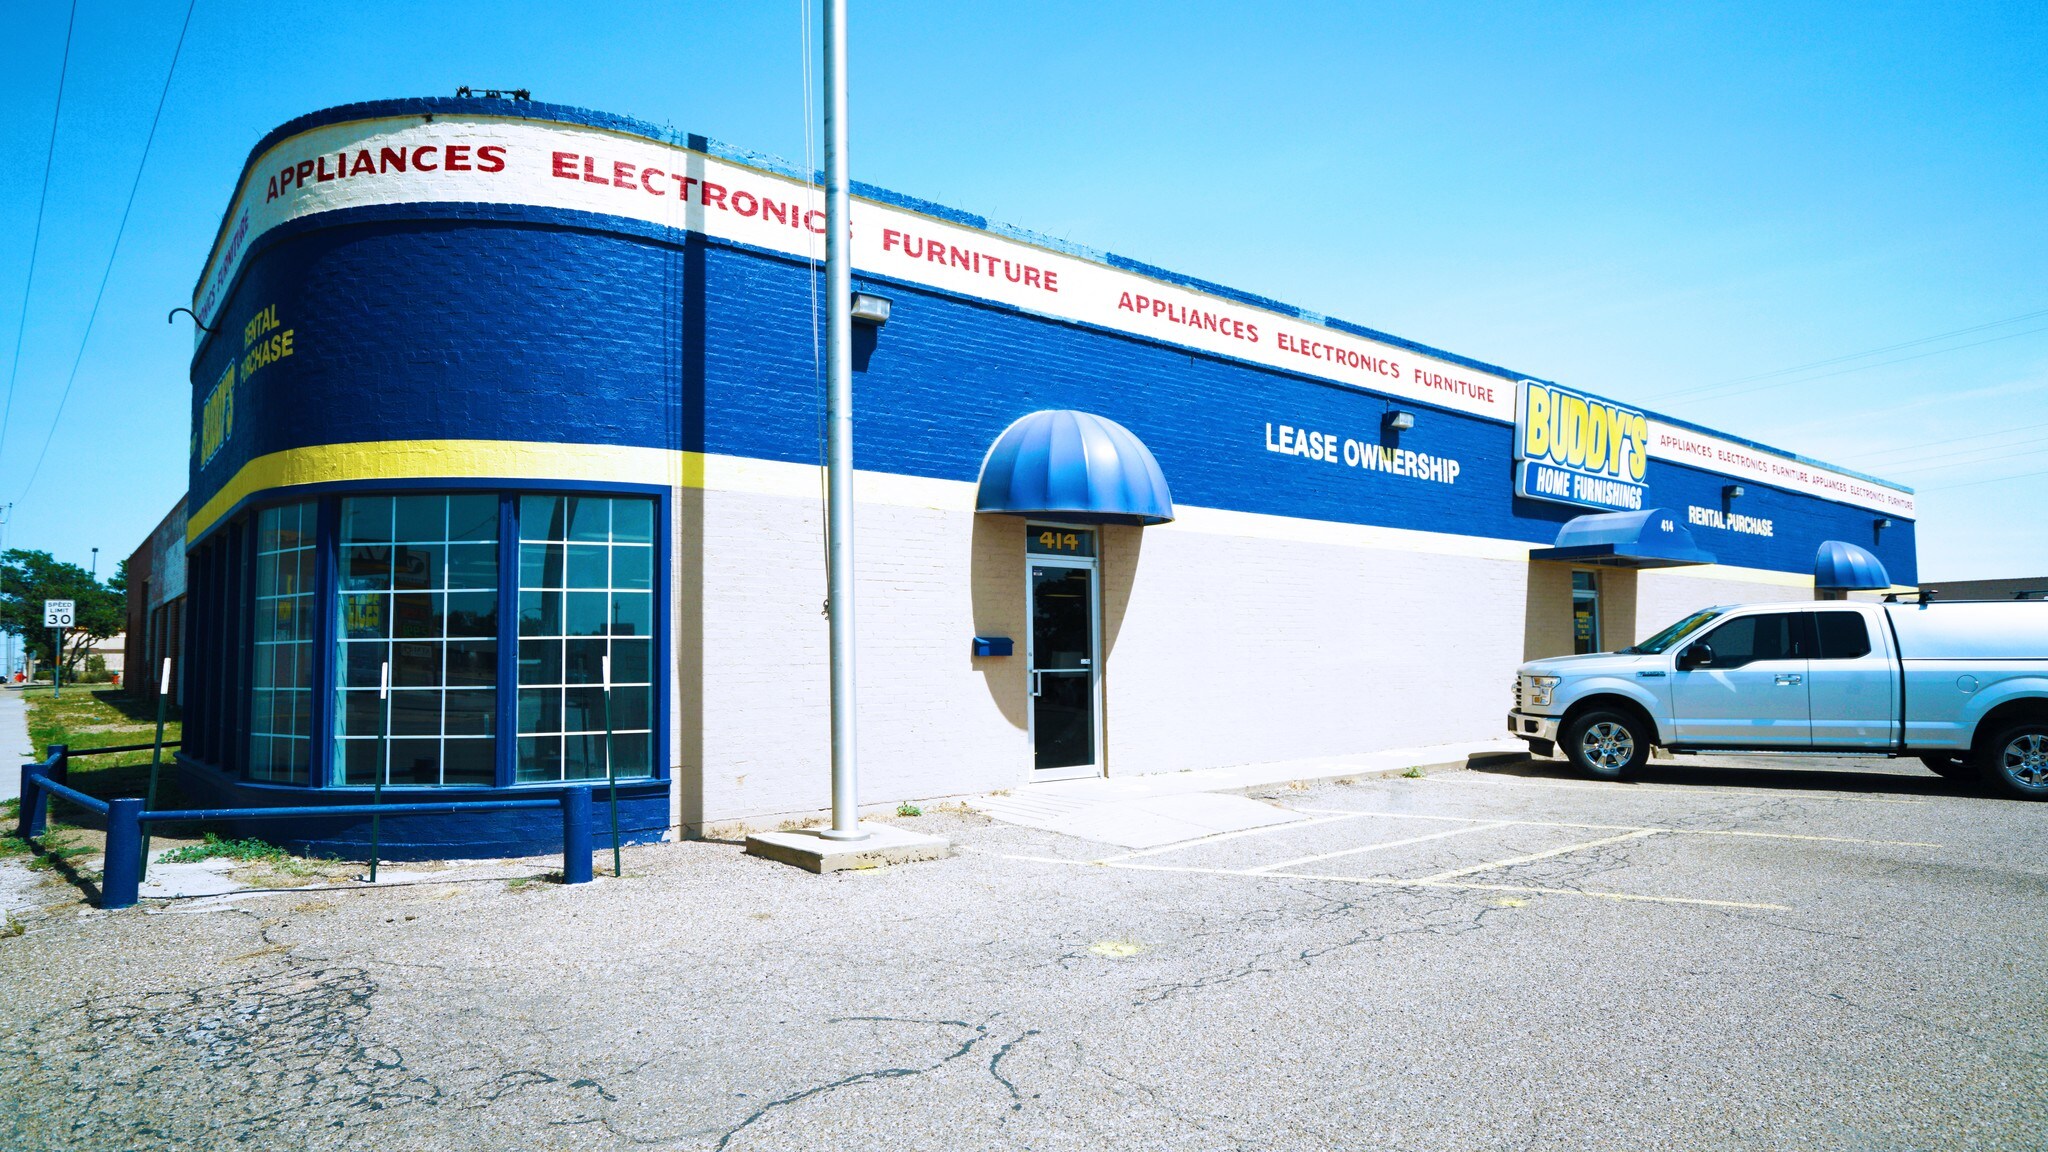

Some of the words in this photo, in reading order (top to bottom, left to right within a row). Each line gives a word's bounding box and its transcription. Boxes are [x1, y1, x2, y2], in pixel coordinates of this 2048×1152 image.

[266, 145, 507, 204] APPLIANCES
[883, 228, 1059, 293] FURNITURE
[245, 303, 280, 351] RENTAL
[1118, 291, 1259, 343] APPLIANCES
[1277, 332, 1400, 379] ELECTRONICS
[1414, 369, 1495, 403] FURNITURE
[240, 329, 294, 387] PURCHASE
[1266, 422, 1338, 463] LEASE
[1343, 439, 1460, 484] OWNERSHIP
[1526, 384, 1648, 480] BUDDY'S
[1536, 466, 1571, 497] HOME
[1573, 474, 1643, 510] FURNISHINGS
[1660, 435, 1713, 458] APPLIANCES
[1718, 450, 1767, 473] ELECTRONICS
[1772, 464, 1808, 483] FURNITURE
[1812, 475, 1847, 492] APPLIANCES
[1039, 531, 1079, 551] 414
[1660, 519, 1674, 532] 414
[1688, 505, 1726, 530] RENTAL
[1727, 512, 1773, 537] PURCHASE
[48, 614, 71, 625] 30
